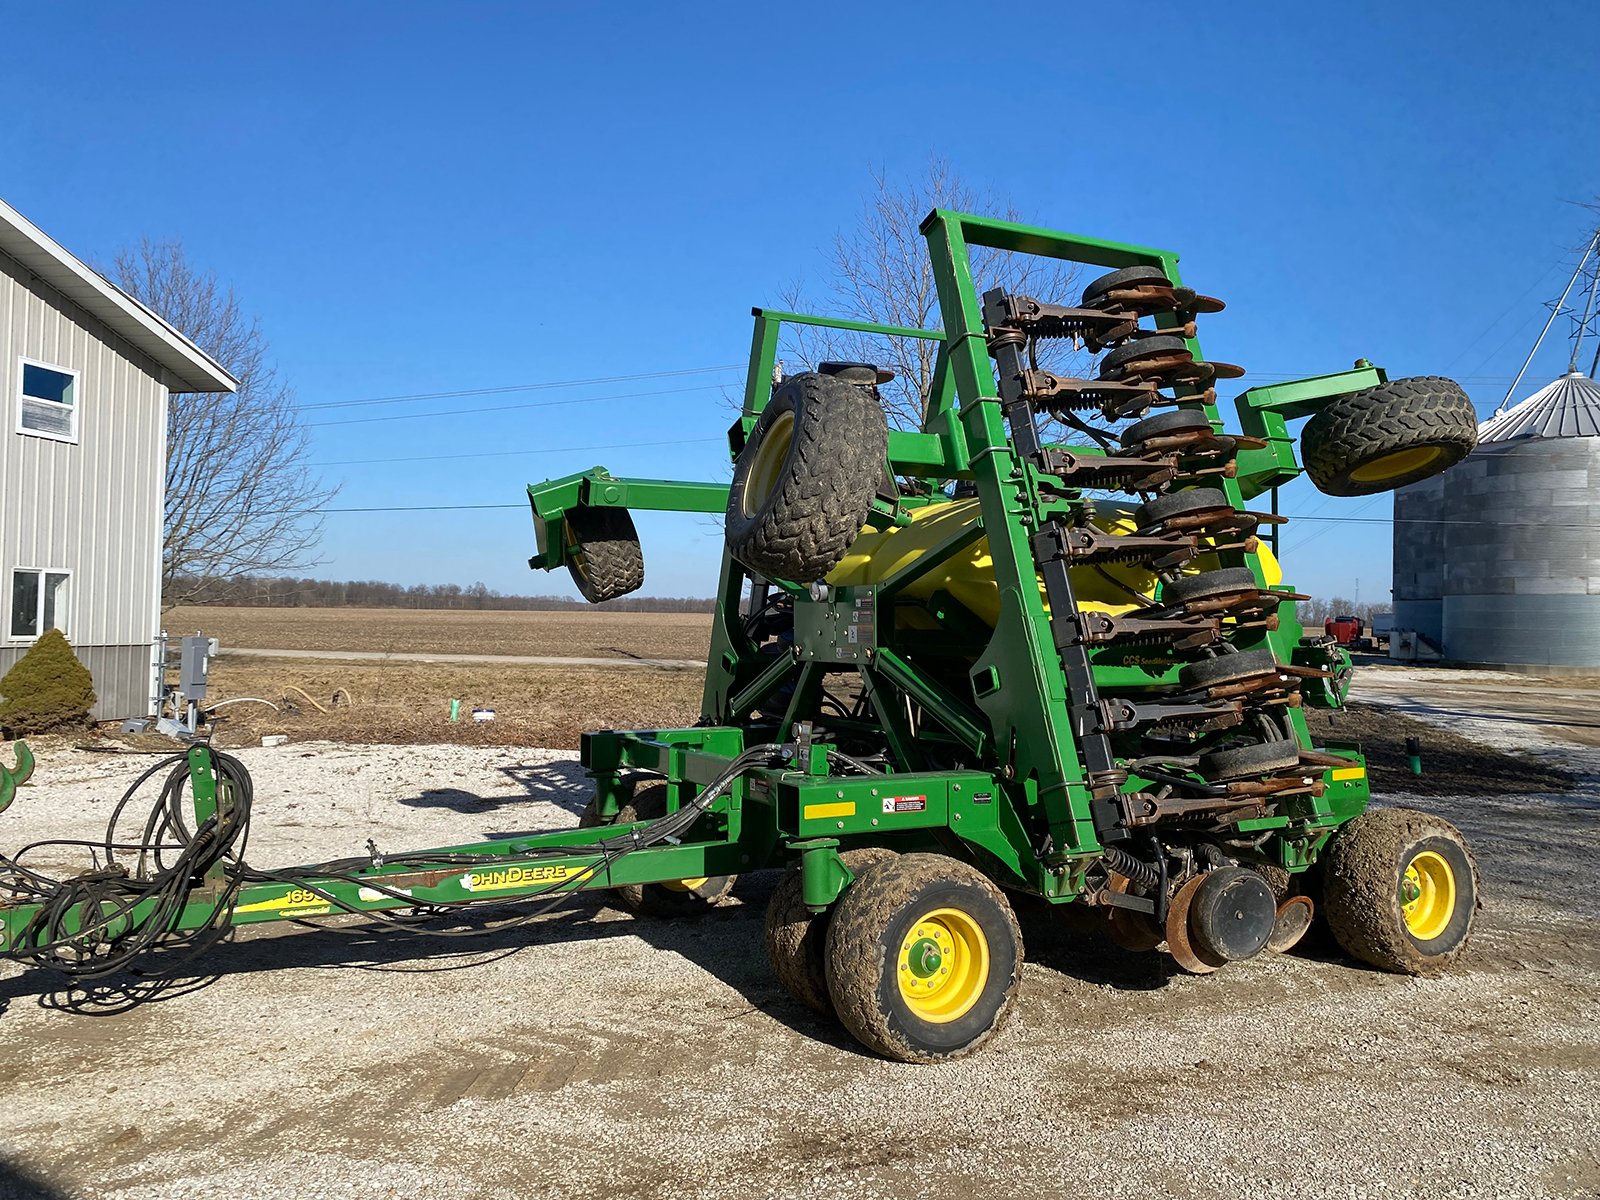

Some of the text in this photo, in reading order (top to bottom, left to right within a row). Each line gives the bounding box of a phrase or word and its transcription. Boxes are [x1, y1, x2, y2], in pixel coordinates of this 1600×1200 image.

[1123, 655, 1140, 665] CCS
[470, 865, 566, 887] OHN DEERE
[286, 889, 323, 904] 169
